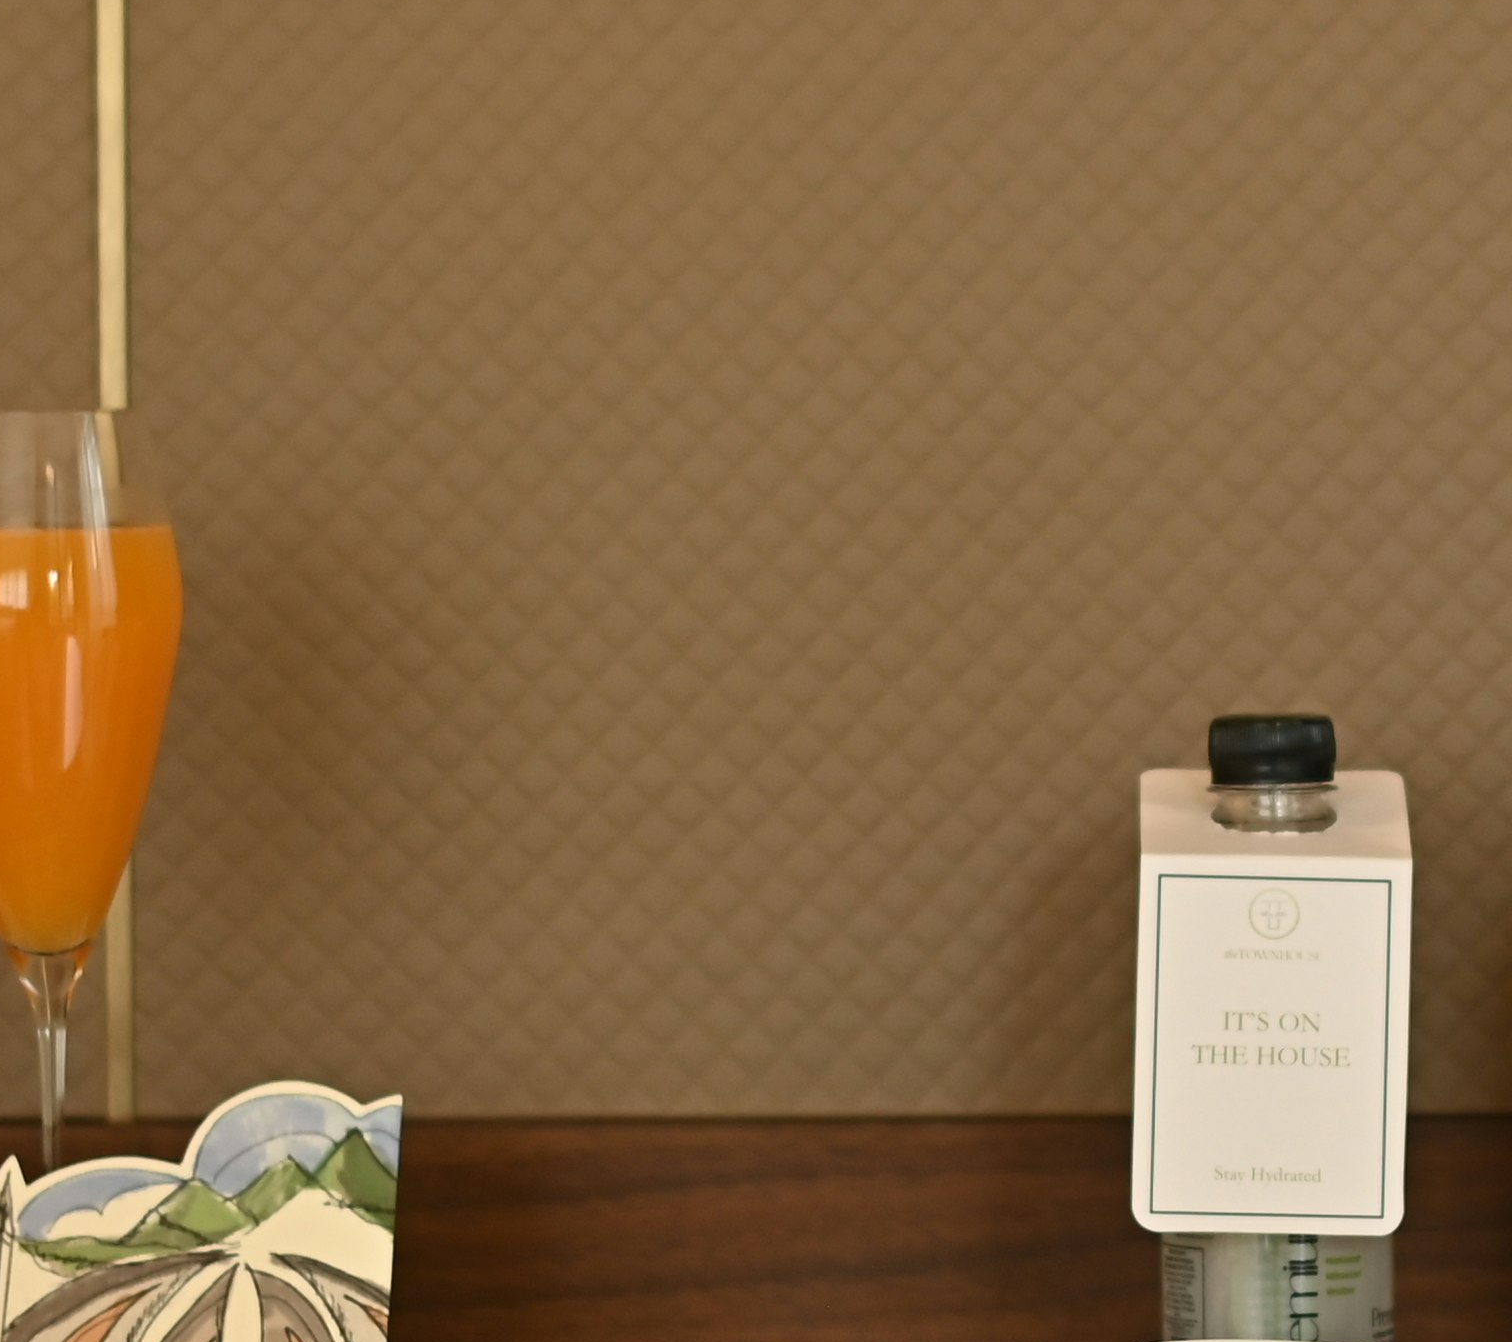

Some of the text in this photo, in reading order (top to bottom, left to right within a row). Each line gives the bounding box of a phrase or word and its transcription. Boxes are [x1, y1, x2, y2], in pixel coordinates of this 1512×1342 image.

[1279, 1012, 1320, 1033] ON
[1191, 1044, 1351, 1067] THE HOUSE
[1214, 1166, 1321, 1186] Stay Hydrated
